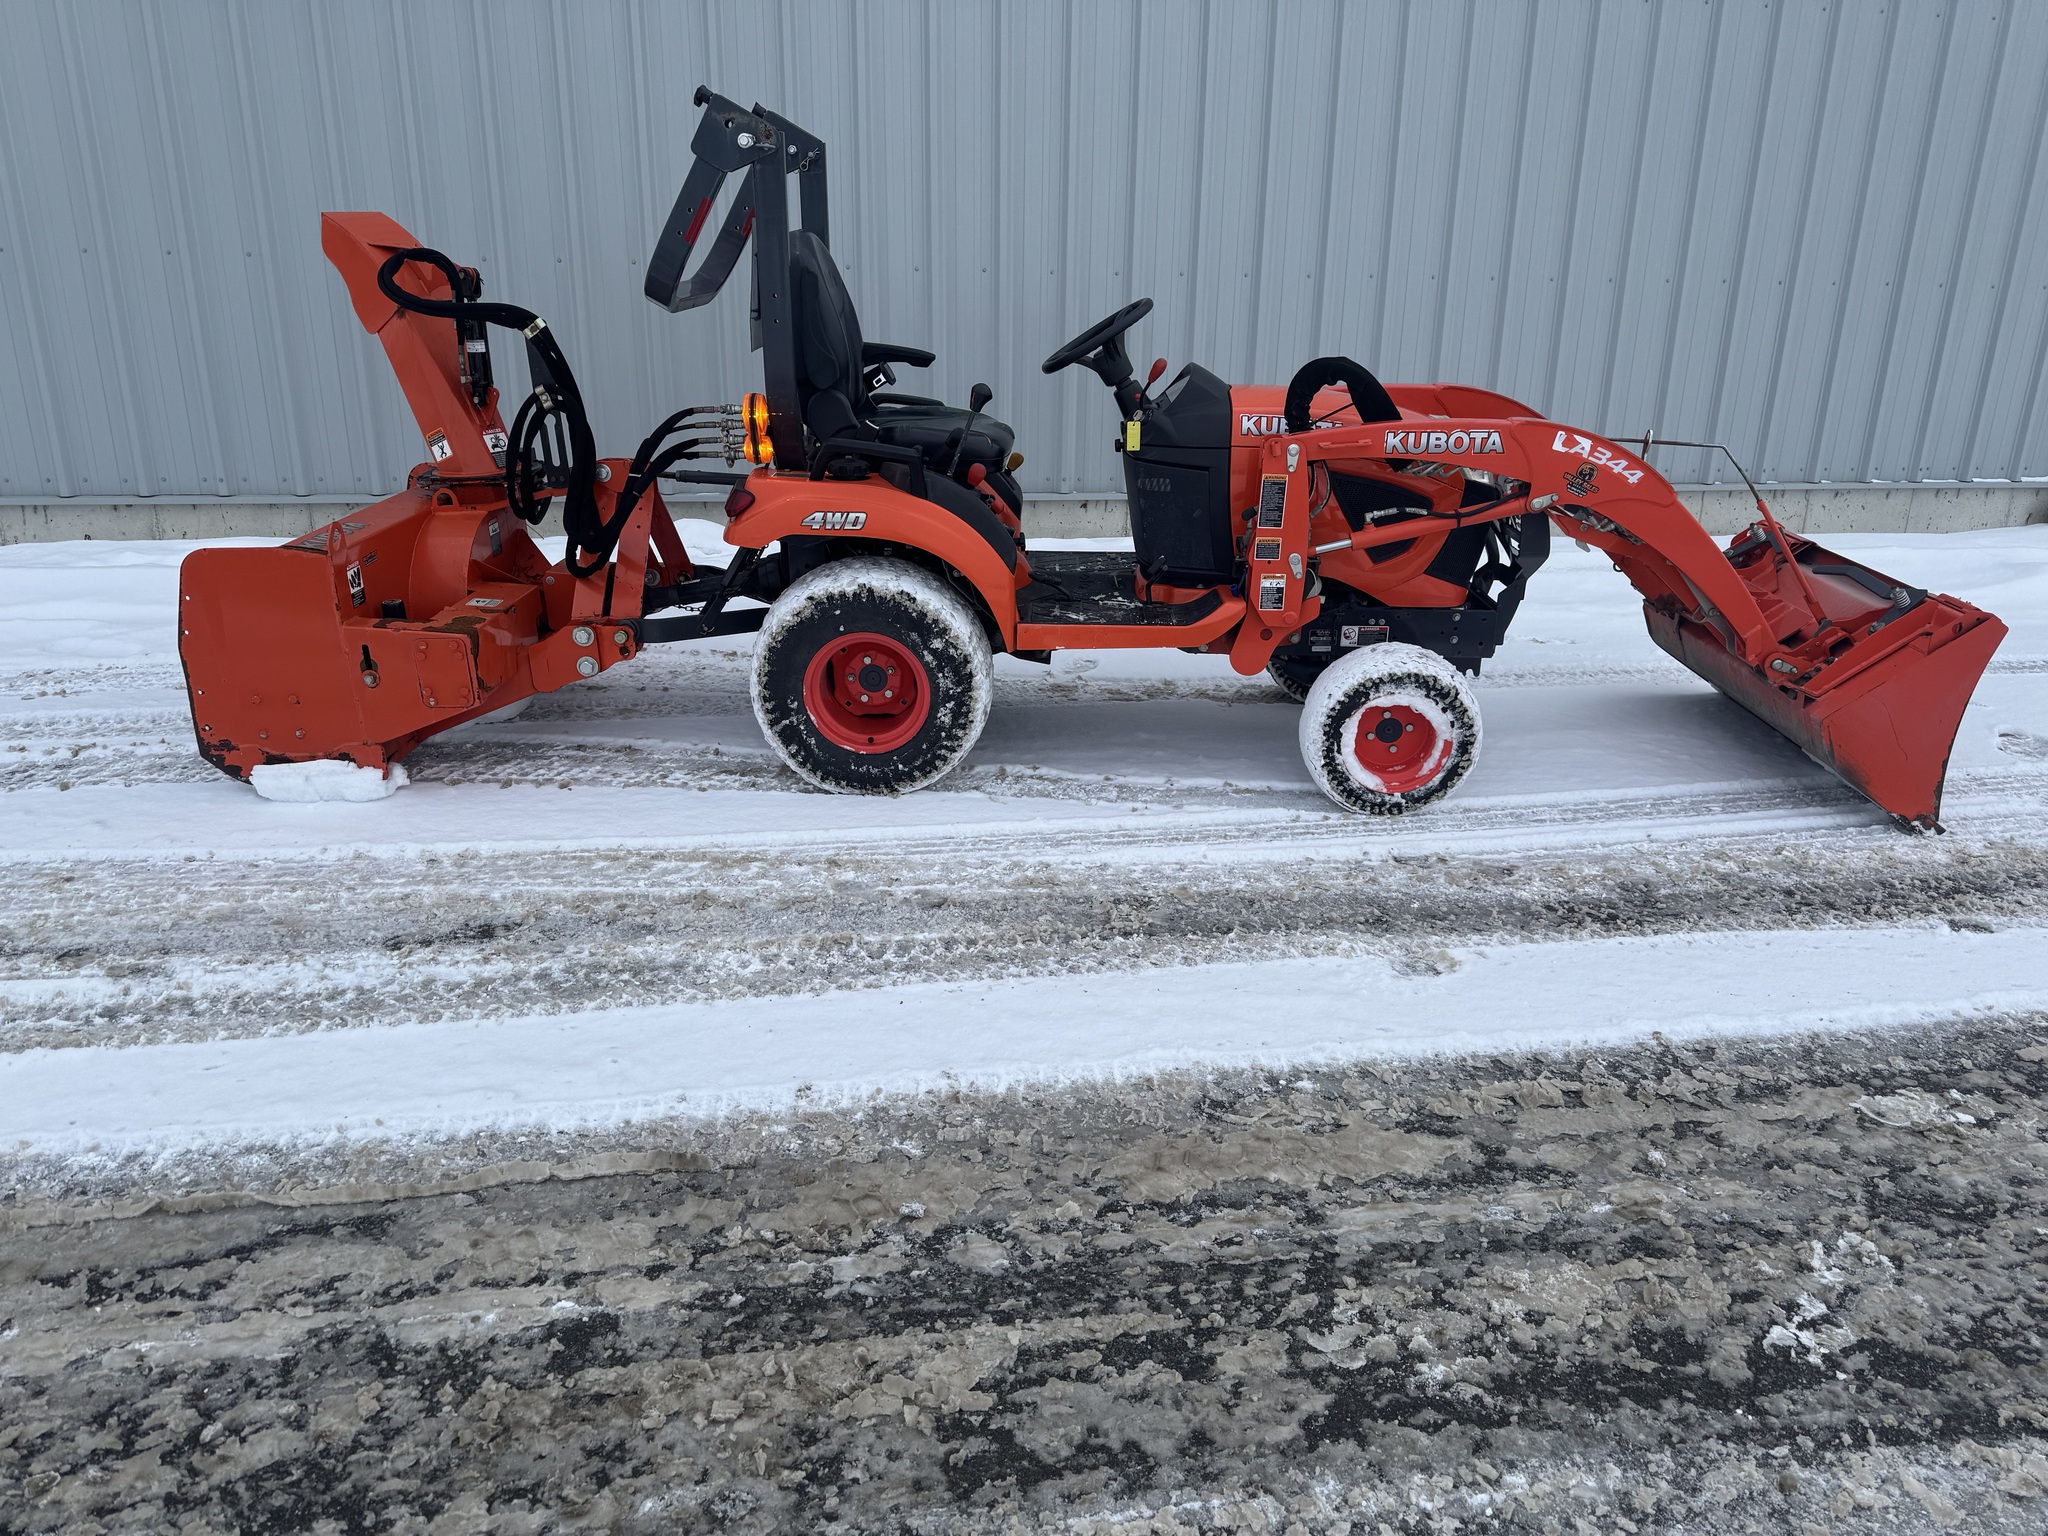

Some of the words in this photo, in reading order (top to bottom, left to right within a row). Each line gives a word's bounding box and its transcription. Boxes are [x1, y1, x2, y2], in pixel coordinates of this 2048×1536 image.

[1240, 414, 1343, 437] KUB
[1385, 429, 1505, 454] KUBOTA
[1552, 431, 1644, 484] LA344
[801, 511, 868, 530] 4WD
